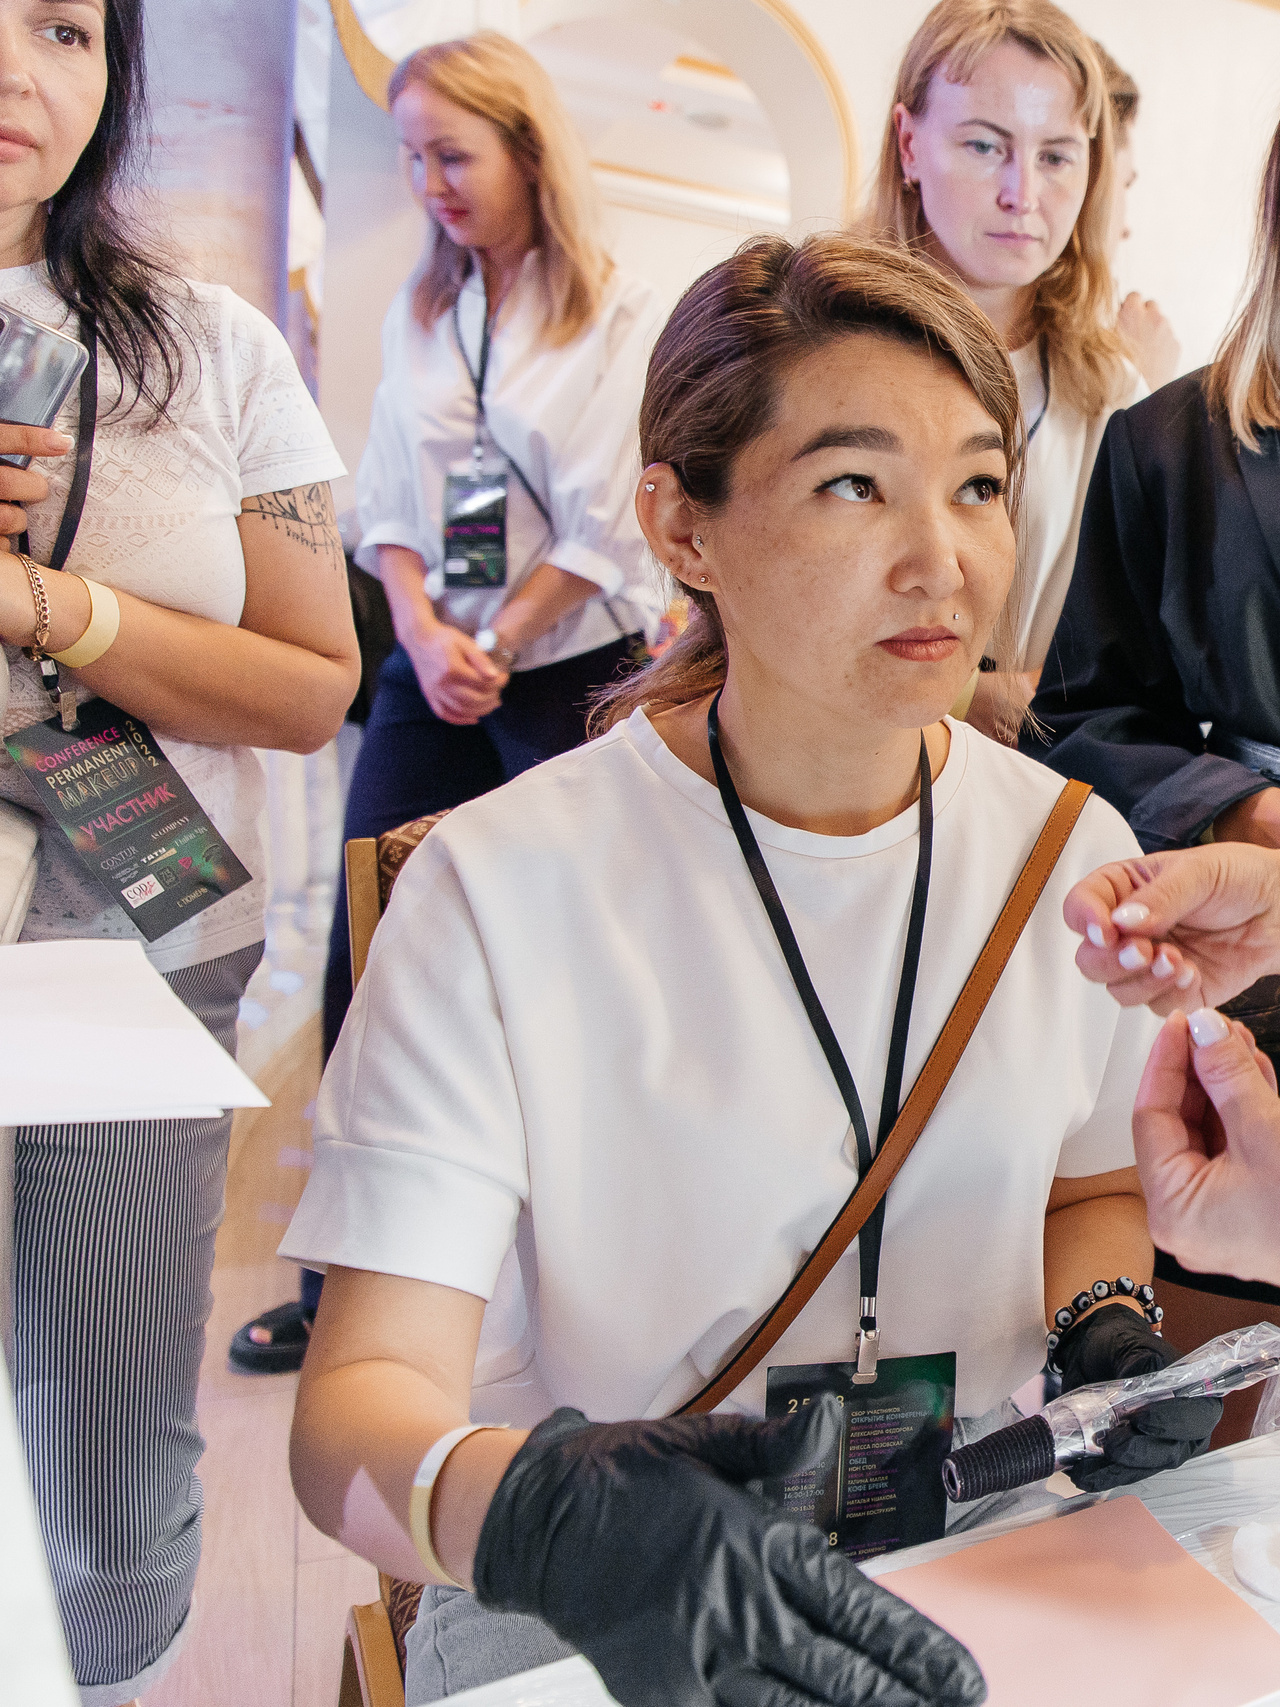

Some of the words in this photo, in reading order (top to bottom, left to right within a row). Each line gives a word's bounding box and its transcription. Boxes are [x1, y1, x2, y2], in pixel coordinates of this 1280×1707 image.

[35, 727, 120, 772] CONFERENCE
[125, 721, 160, 767] 2022
[45, 741, 130, 789] PERMANENT
[57, 757, 139, 811] MAKEUP
[79, 782, 176, 841] УЧАСТНИК
[100, 845, 139, 870] CONTUR
[850, 1415, 885, 1424] ОТКРЫТИЕ
[850, 1430, 885, 1438] АЛЕКСАНДРА
[848, 1457, 868, 1465] ОБЕД
[847, 1485, 867, 1493] КОФЕ
